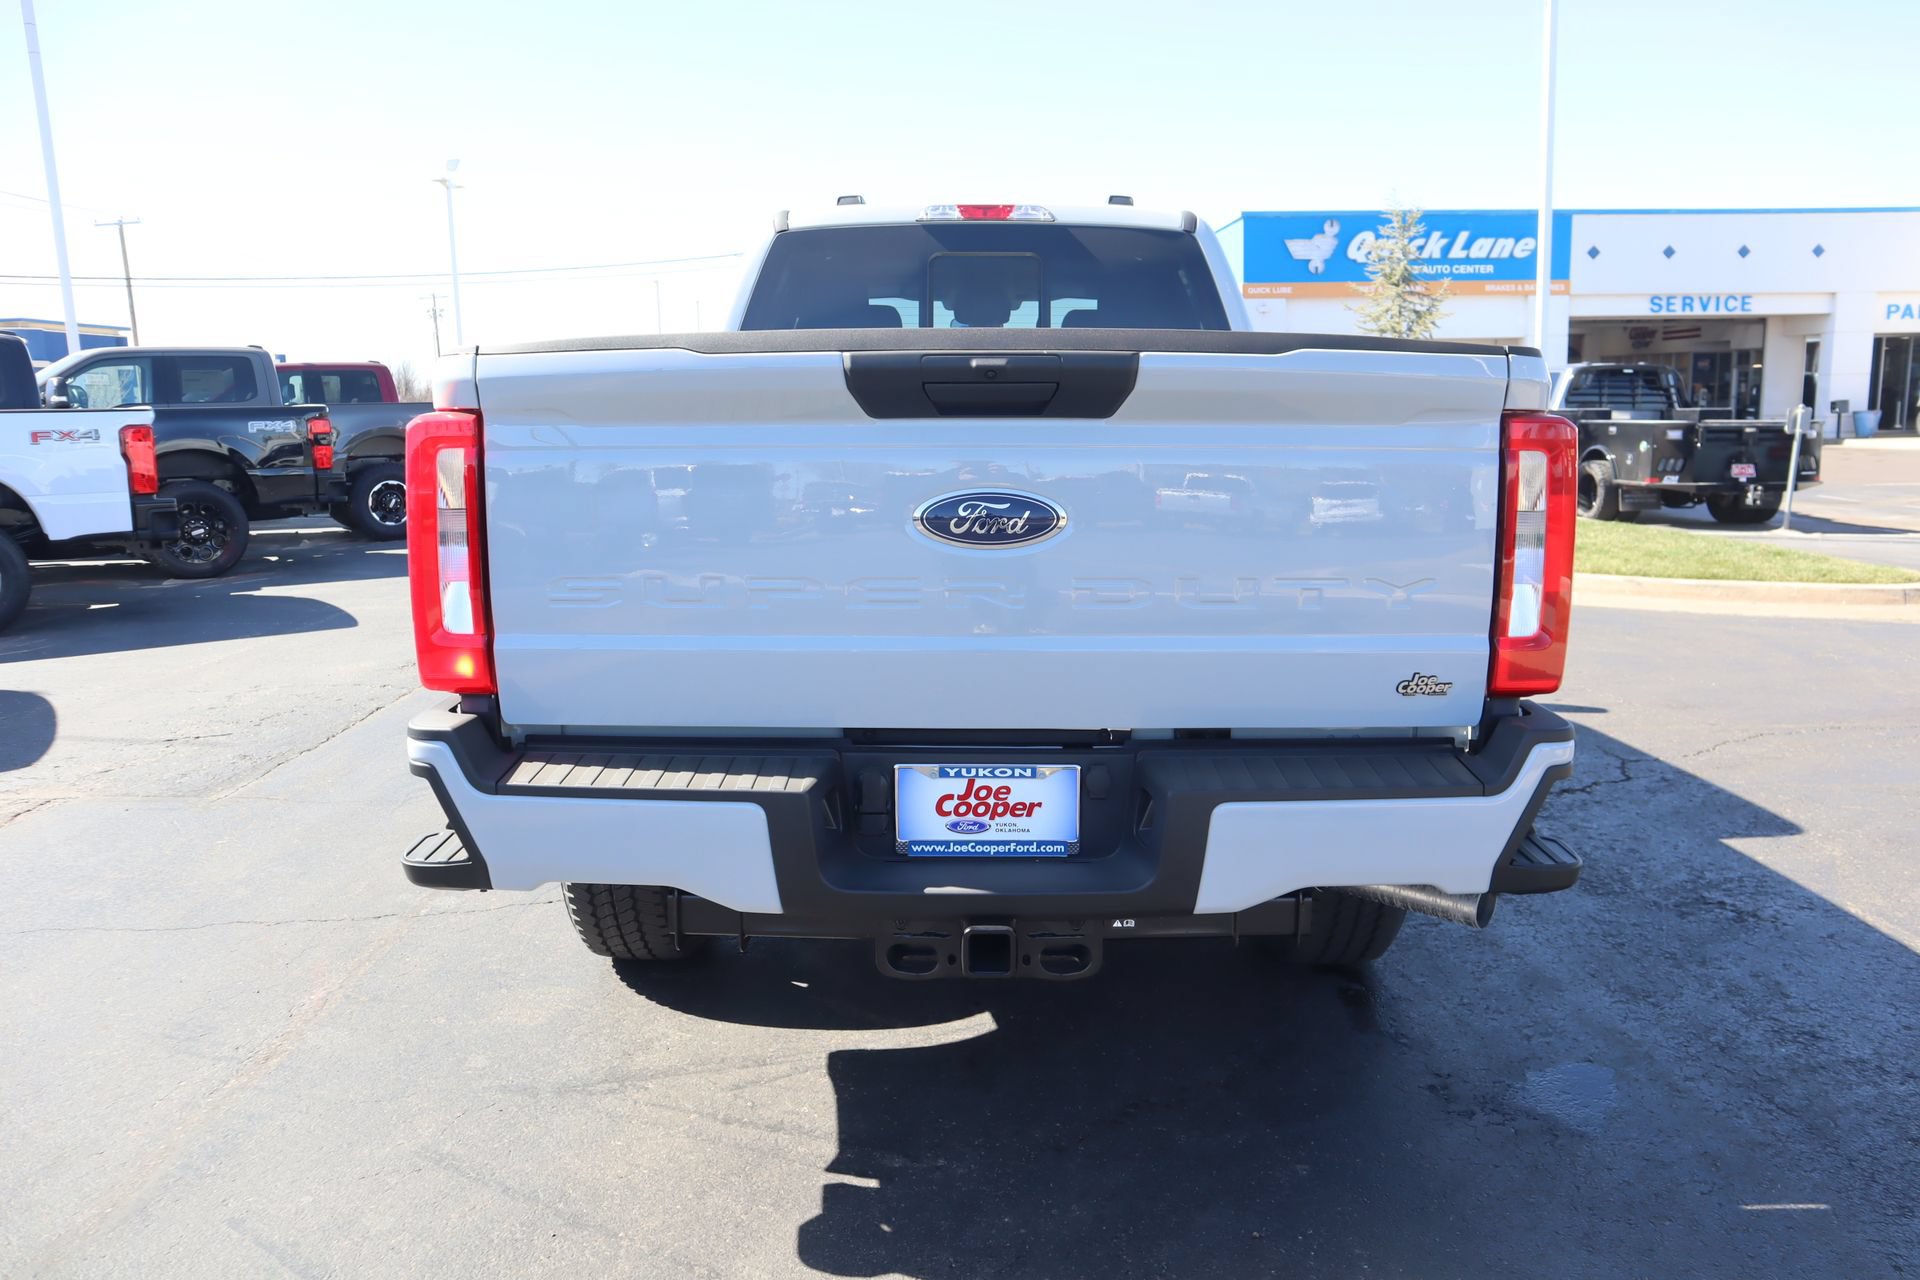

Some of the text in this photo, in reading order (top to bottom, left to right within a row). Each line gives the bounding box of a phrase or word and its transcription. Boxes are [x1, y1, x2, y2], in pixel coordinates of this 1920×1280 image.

[1447, 230, 1536, 259] Lane
[1423, 264, 1450, 274] AUTO
[1452, 264, 1494, 274] CENTER
[1649, 295, 1753, 313] SERVICE
[1886, 303, 1920, 320] PA
[248, 420, 297, 433] FX4
[29, 428, 101, 445] FX4
[949, 501, 1031, 535] Ford
[547, 576, 1437, 609] SUPER DUTY
[1409, 672, 1438, 685] Joe
[1396, 680, 1453, 695] Cooper
[945, 767, 1032, 777] YUKON
[957, 778, 1012, 802] Joe
[935, 793, 1042, 820] Cooper
[957, 821, 979, 832] Ford
[911, 842, 1065, 855] www.JoeCooperFord.com
